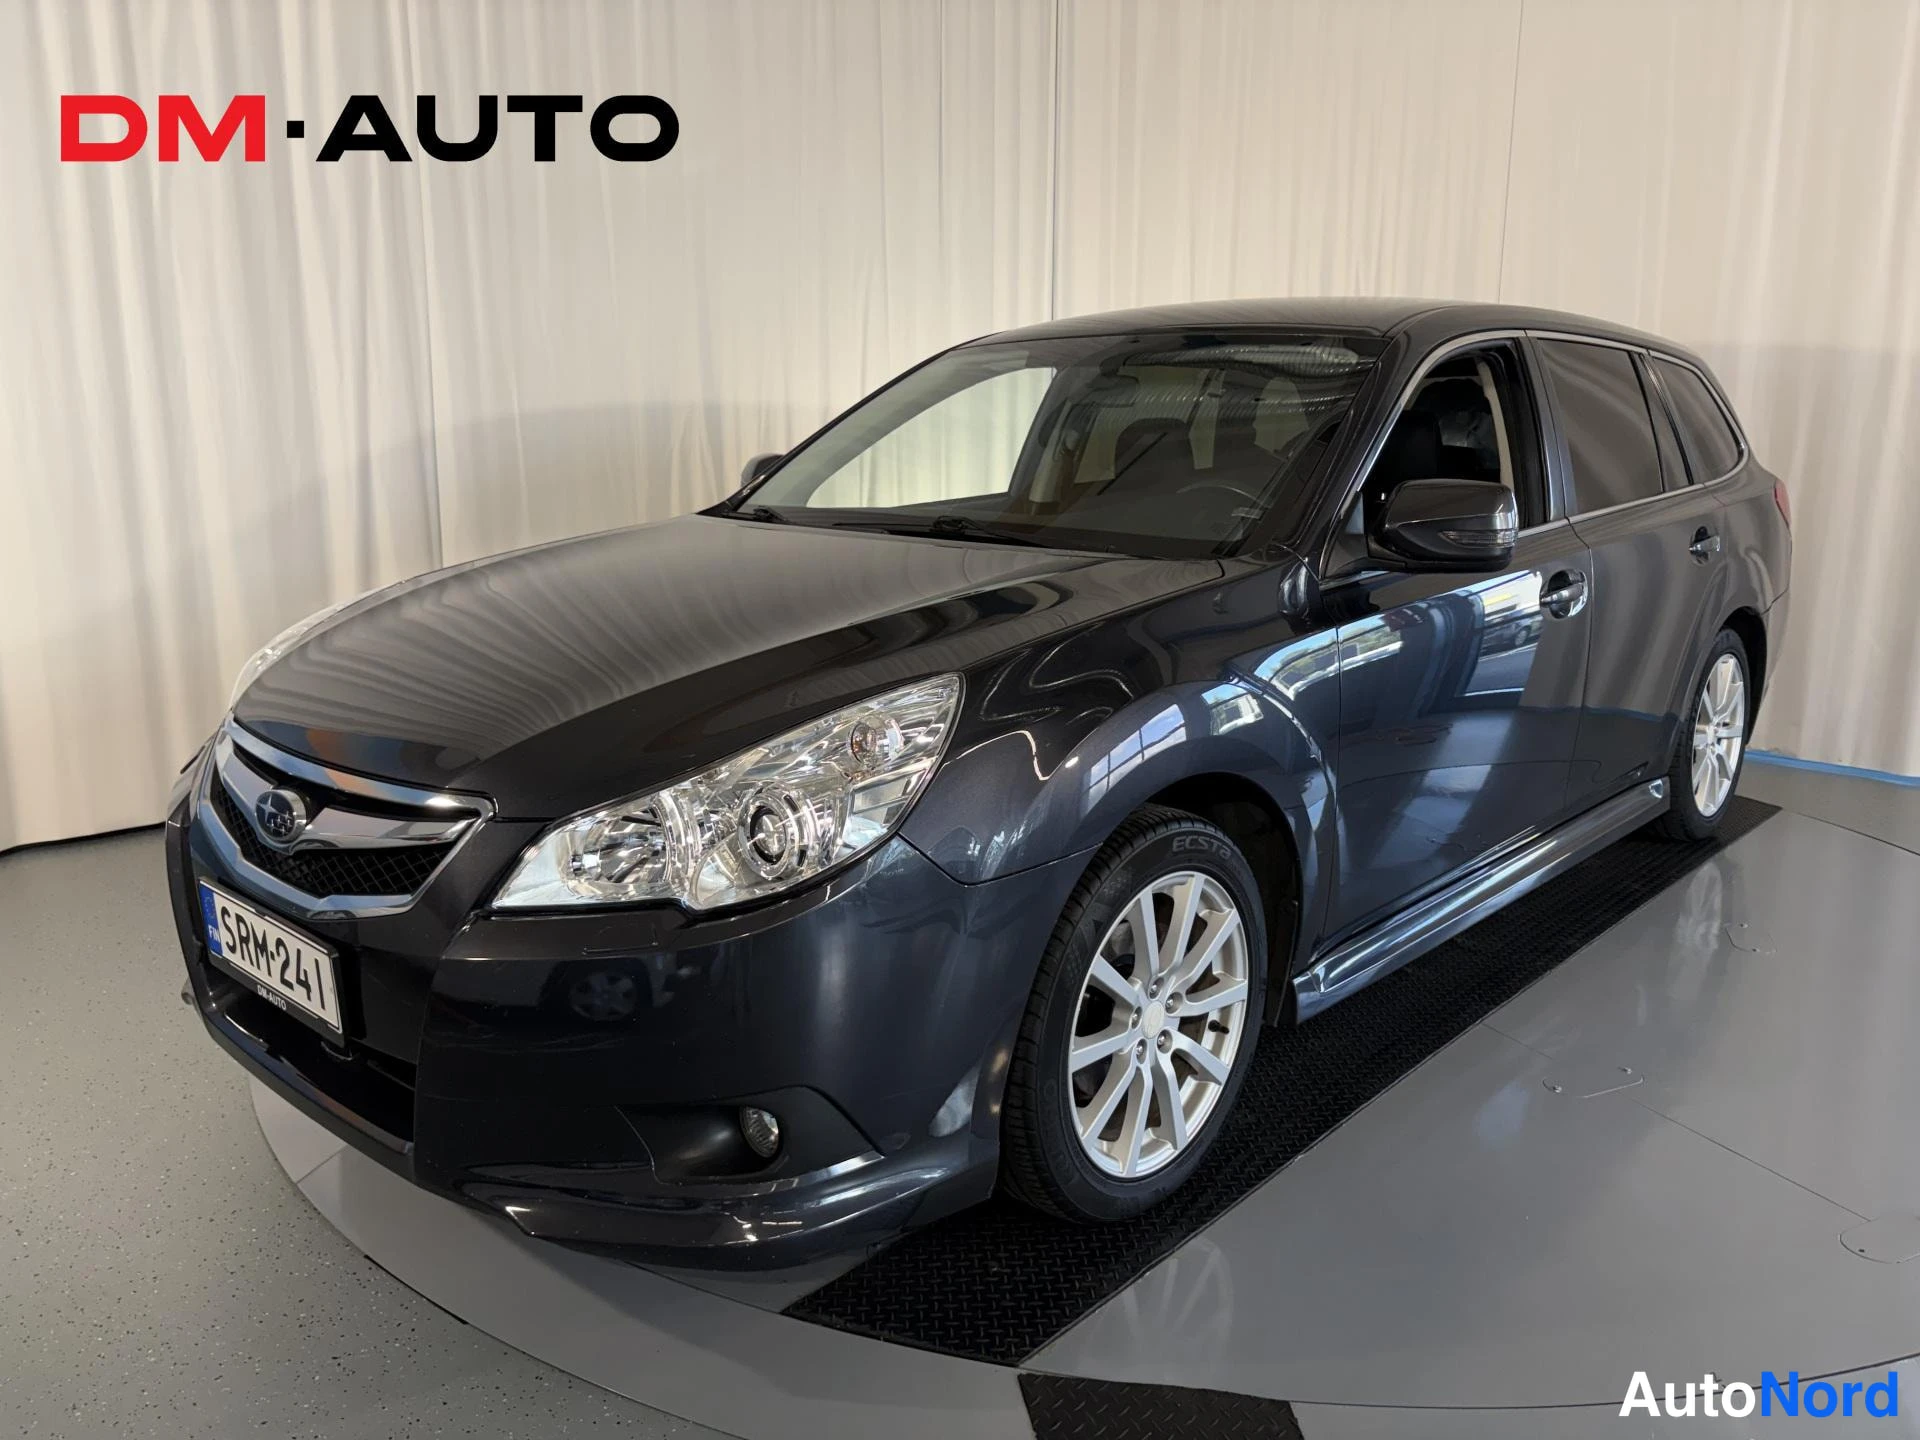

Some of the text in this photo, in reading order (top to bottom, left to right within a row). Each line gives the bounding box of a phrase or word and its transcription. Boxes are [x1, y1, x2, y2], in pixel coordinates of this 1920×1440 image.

[208, 924, 221, 944] FIN
[220, 905, 326, 1011] SRM-241
[257, 984, 287, 1011] DM-AUTO
